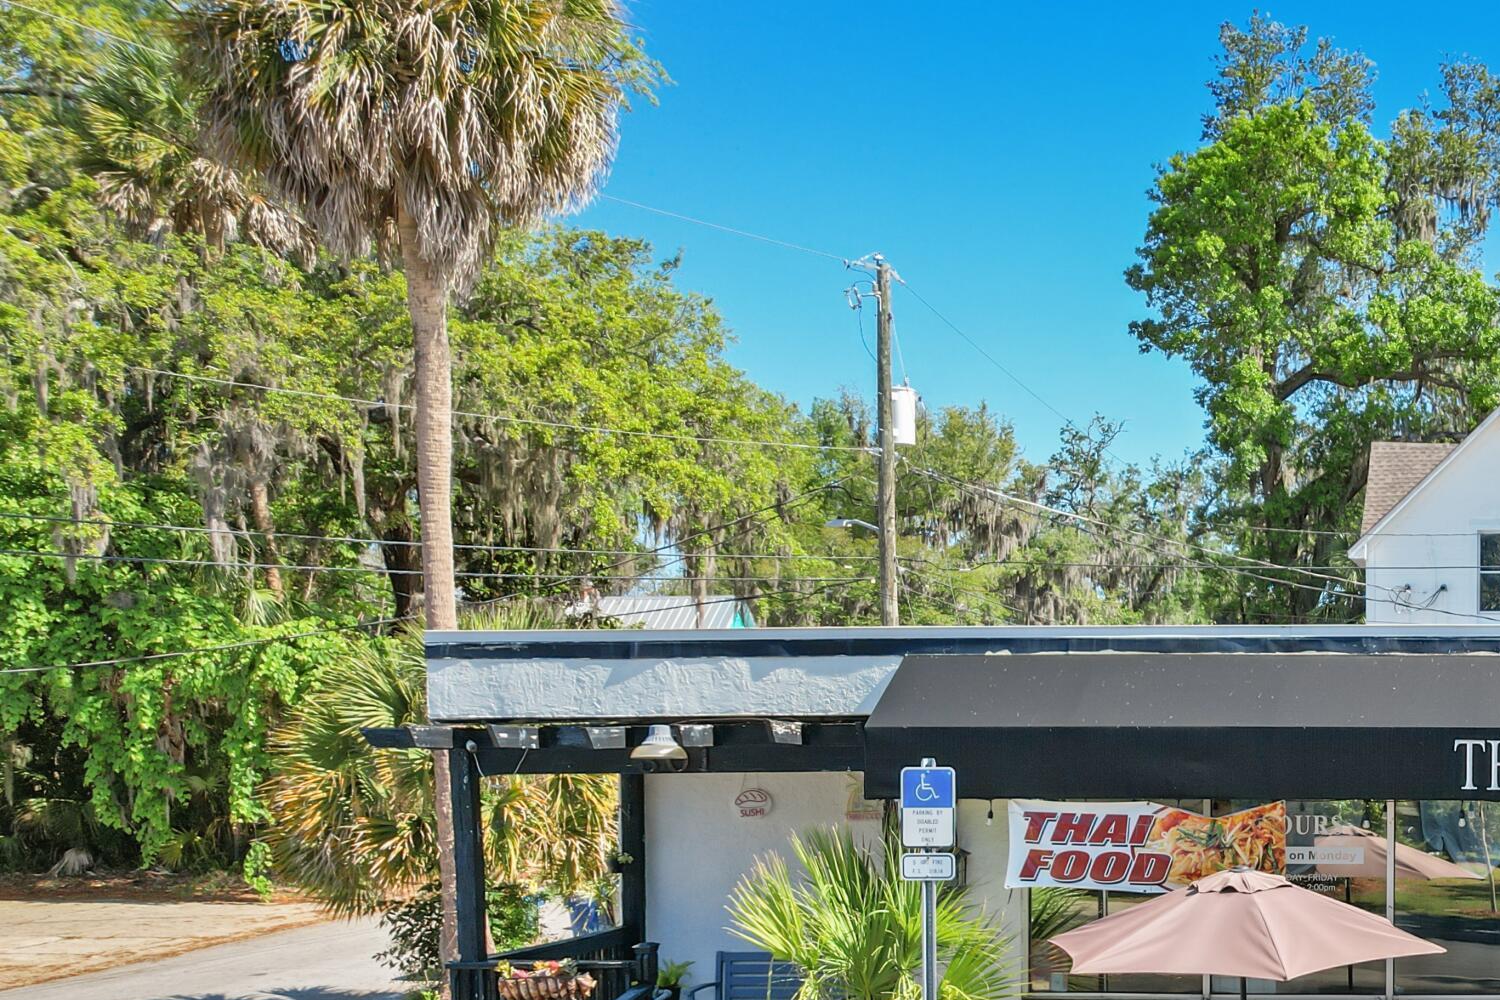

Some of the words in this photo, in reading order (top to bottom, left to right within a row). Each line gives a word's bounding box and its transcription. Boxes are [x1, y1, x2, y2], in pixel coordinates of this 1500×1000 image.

[740, 808, 765, 818] SUSHI
[1023, 811, 1156, 847] THAI
[1284, 814, 1343, 836] OURS
[1289, 851, 1304, 860] on
[1308, 850, 1357, 862] Monday
[1019, 849, 1173, 885] FOOD
[1307, 883, 1336, 892] 2:00pm
